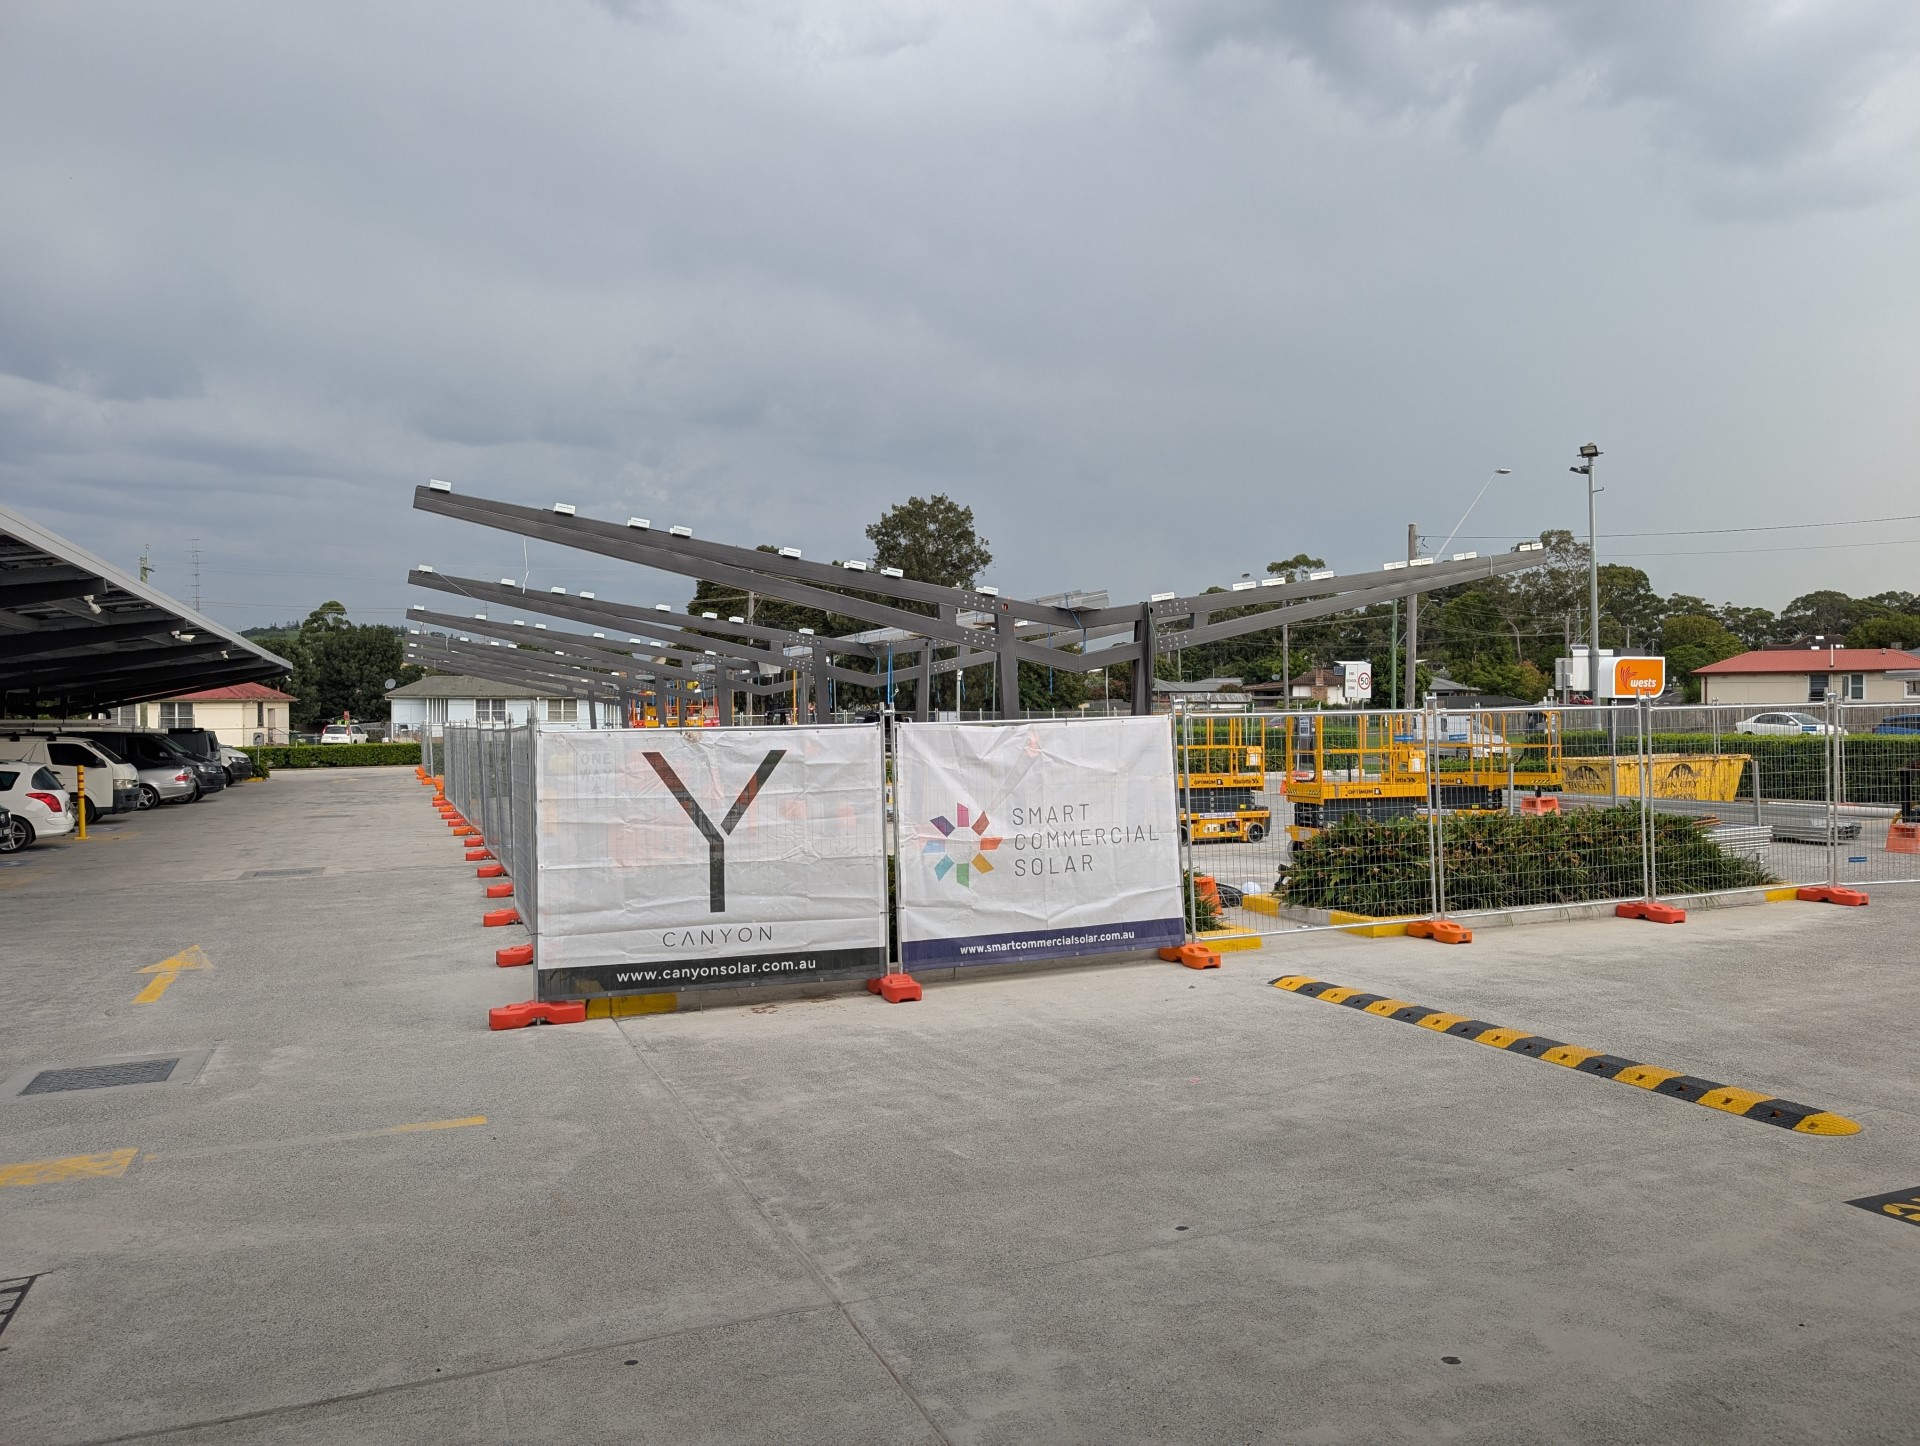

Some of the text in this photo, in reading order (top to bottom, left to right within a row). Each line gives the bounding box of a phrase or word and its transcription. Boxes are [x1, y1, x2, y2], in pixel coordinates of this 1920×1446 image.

[1360, 677, 1368, 685] 50
[1630, 678, 1657, 688] wests
[581, 753, 612, 765] ONE
[580, 769, 612, 781] WAY
[1012, 803, 1090, 826] SMART
[1014, 824, 1160, 851] COMMERCIAL
[1014, 854, 1094, 877] SOLAR
[662, 925, 773, 948] CANYON
[960, 930, 1136, 954] www.smartcommercialsolar.com.au
[616, 958, 817, 983] www.canyonsolar.com.au
